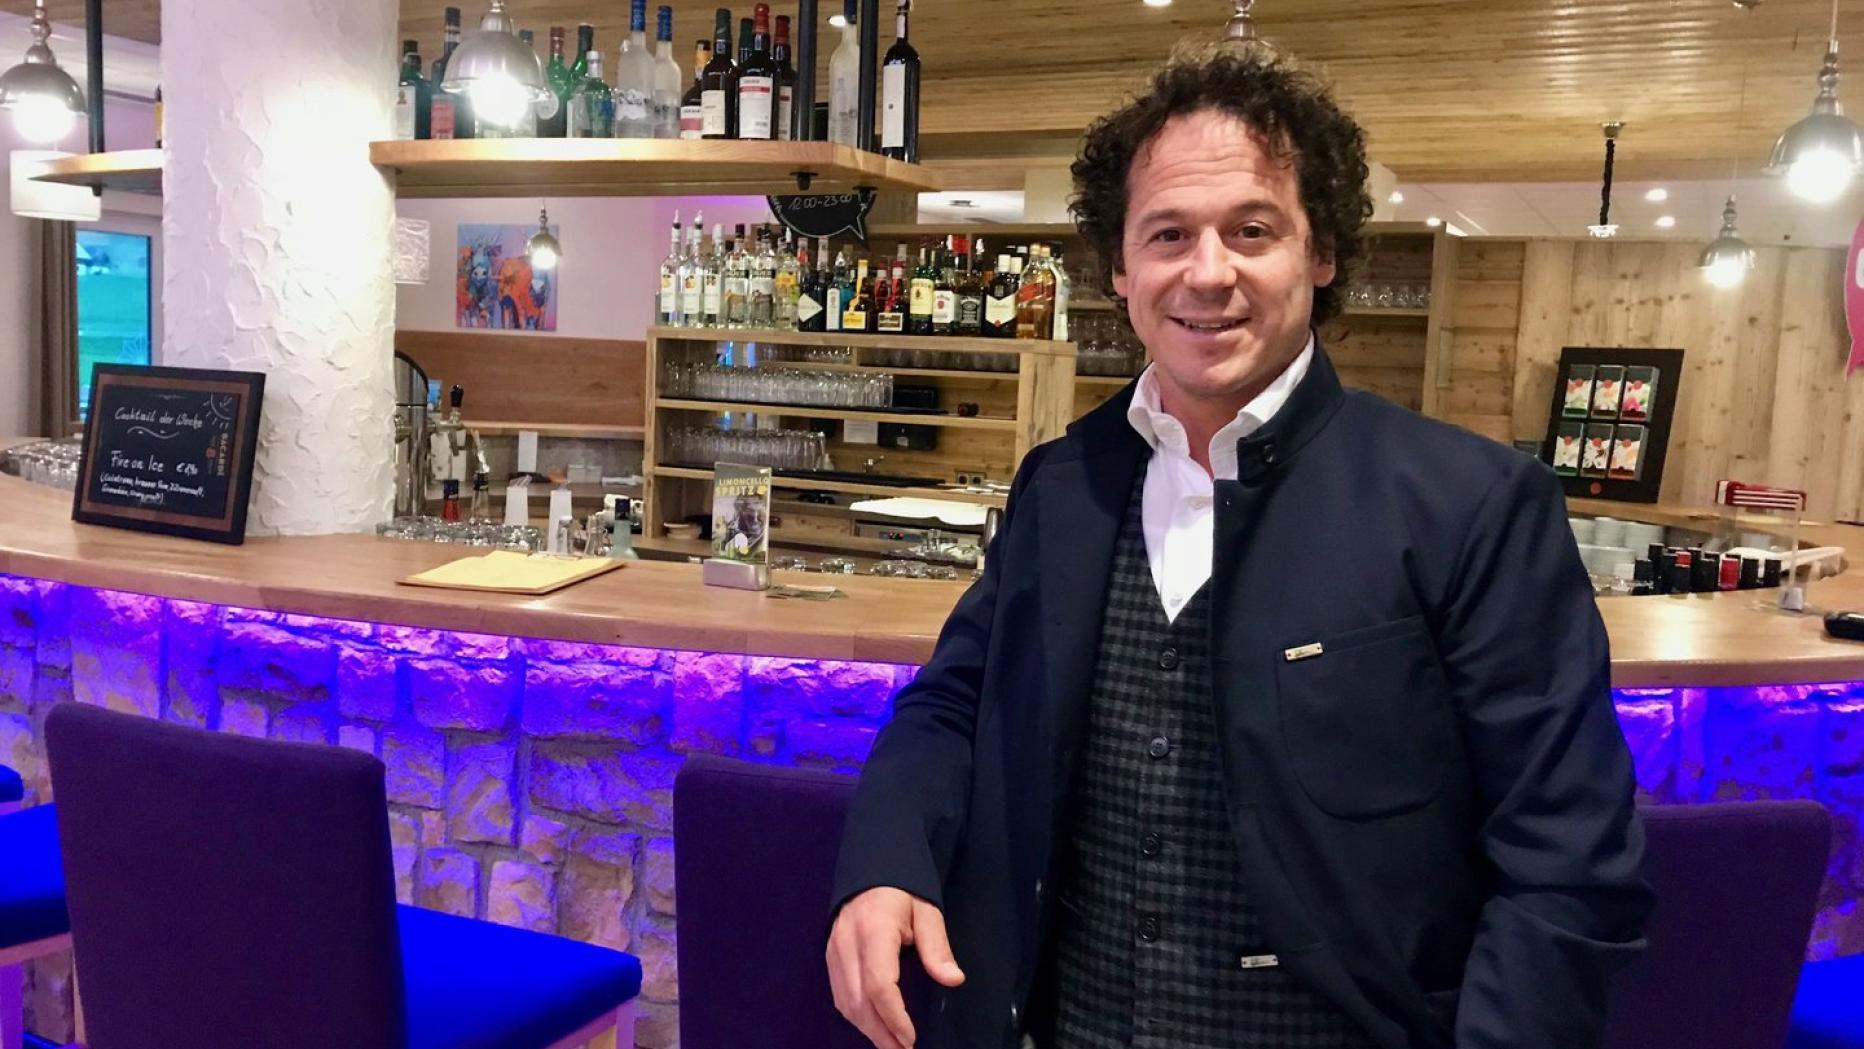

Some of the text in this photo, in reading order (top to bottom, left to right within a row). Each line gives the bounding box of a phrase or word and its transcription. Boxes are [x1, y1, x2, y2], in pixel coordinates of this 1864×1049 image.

[115, 407, 156, 421] Cocktail
[159, 411, 175, 424] der
[110, 450, 129, 468] Fire
[131, 460, 144, 470] on
[148, 454, 164, 473] Ice
[719, 477, 769, 485] LIMONCELLO
[715, 486, 754, 495] SPRITZ
